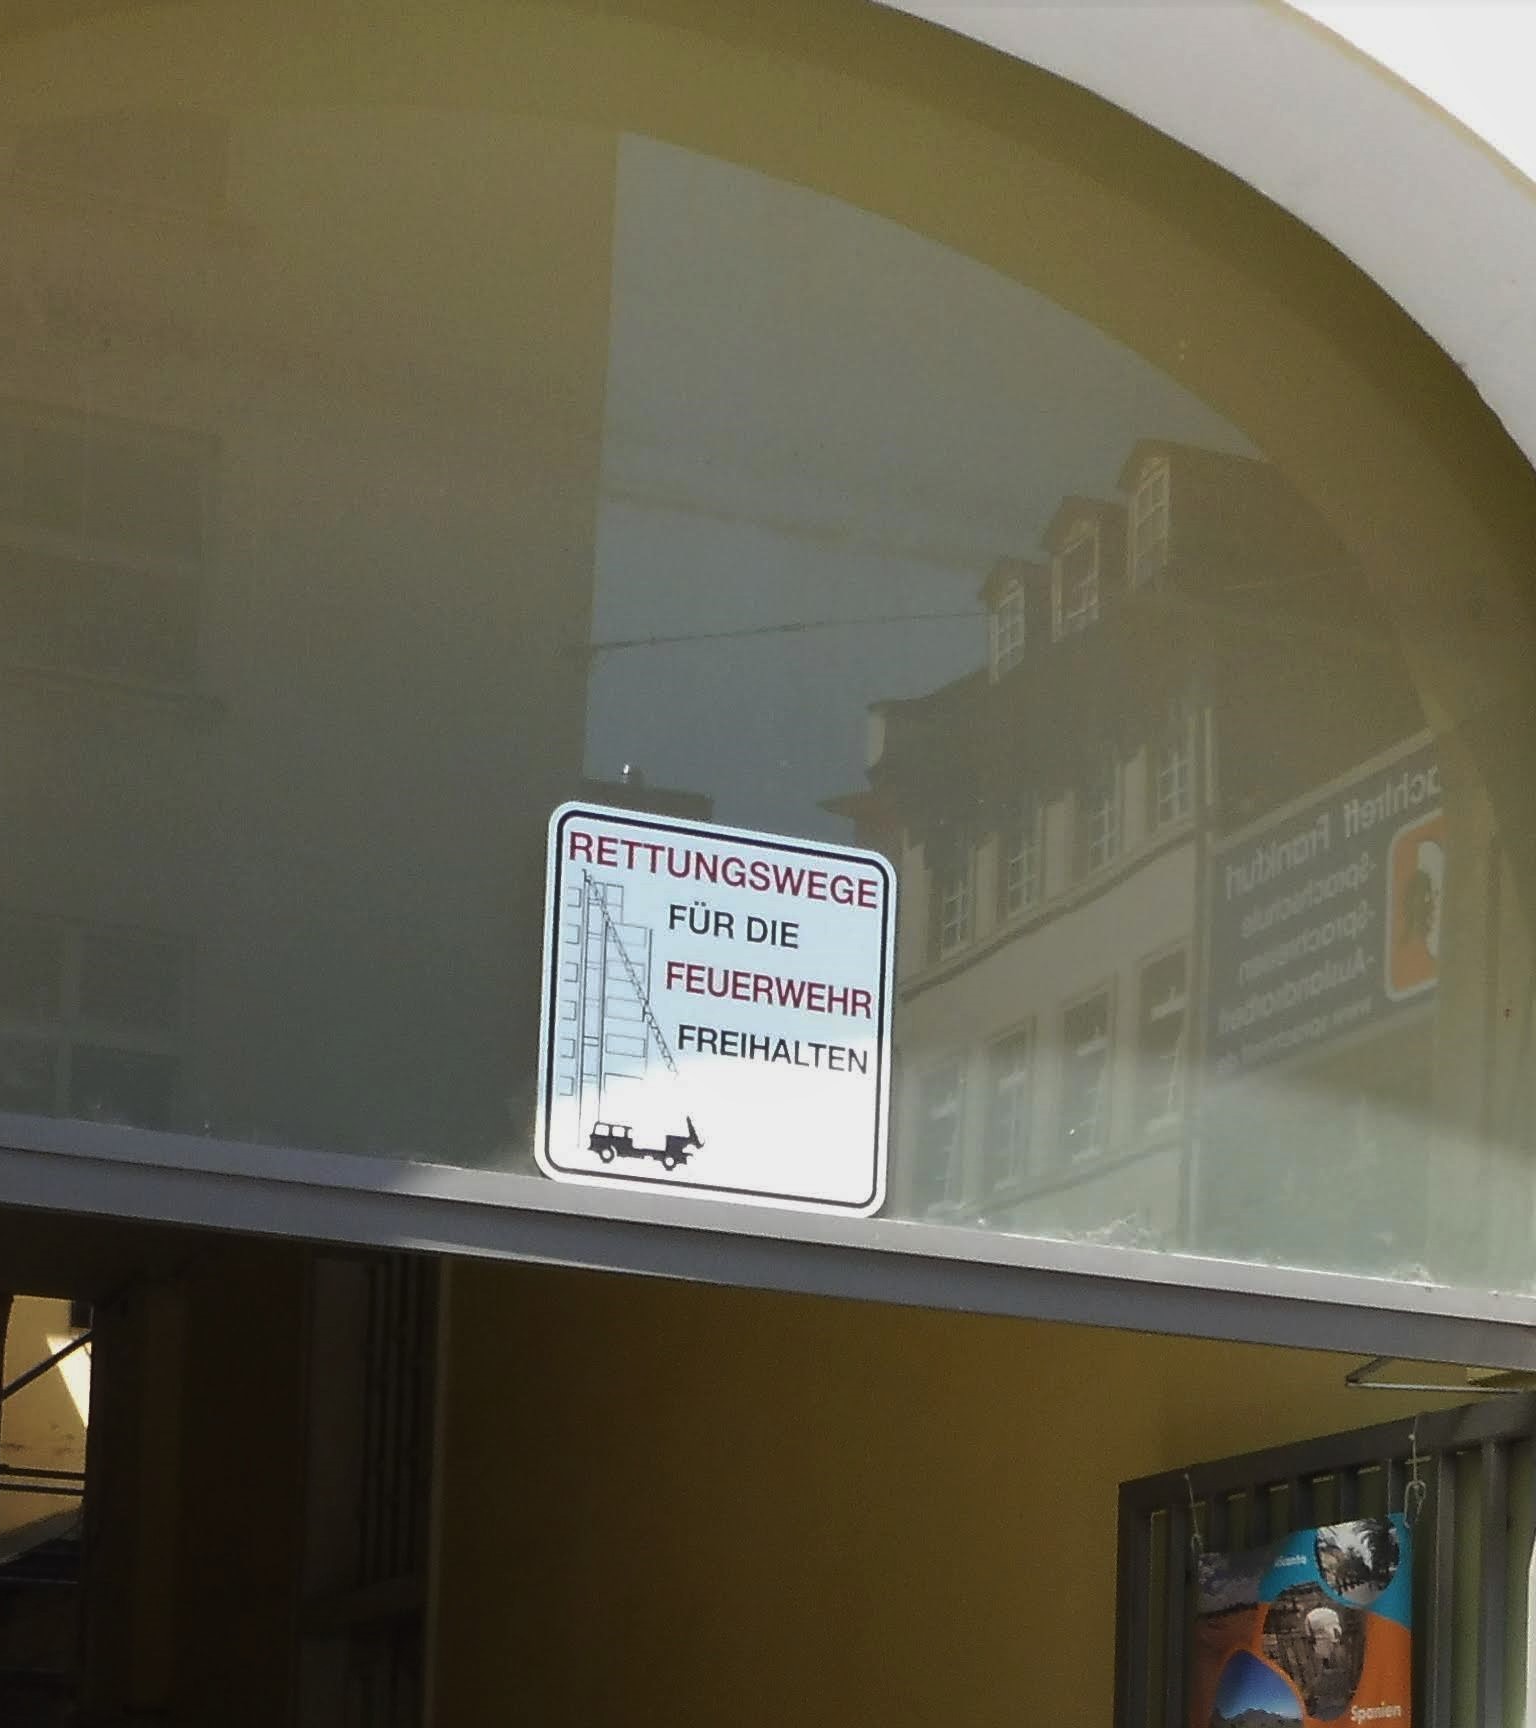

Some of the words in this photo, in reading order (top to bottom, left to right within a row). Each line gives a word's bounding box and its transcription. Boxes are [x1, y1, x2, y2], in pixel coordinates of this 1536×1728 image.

[569, 831, 878, 909] RETTUNGSWEGE
[668, 900, 735, 940] FÜR
[747, 917, 800, 949] DIE
[666, 960, 873, 1019] FEUERWEHR
[678, 1023, 868, 1075] FREIHALTEN
[1350, 1702, 1402, 1723] Spanien
